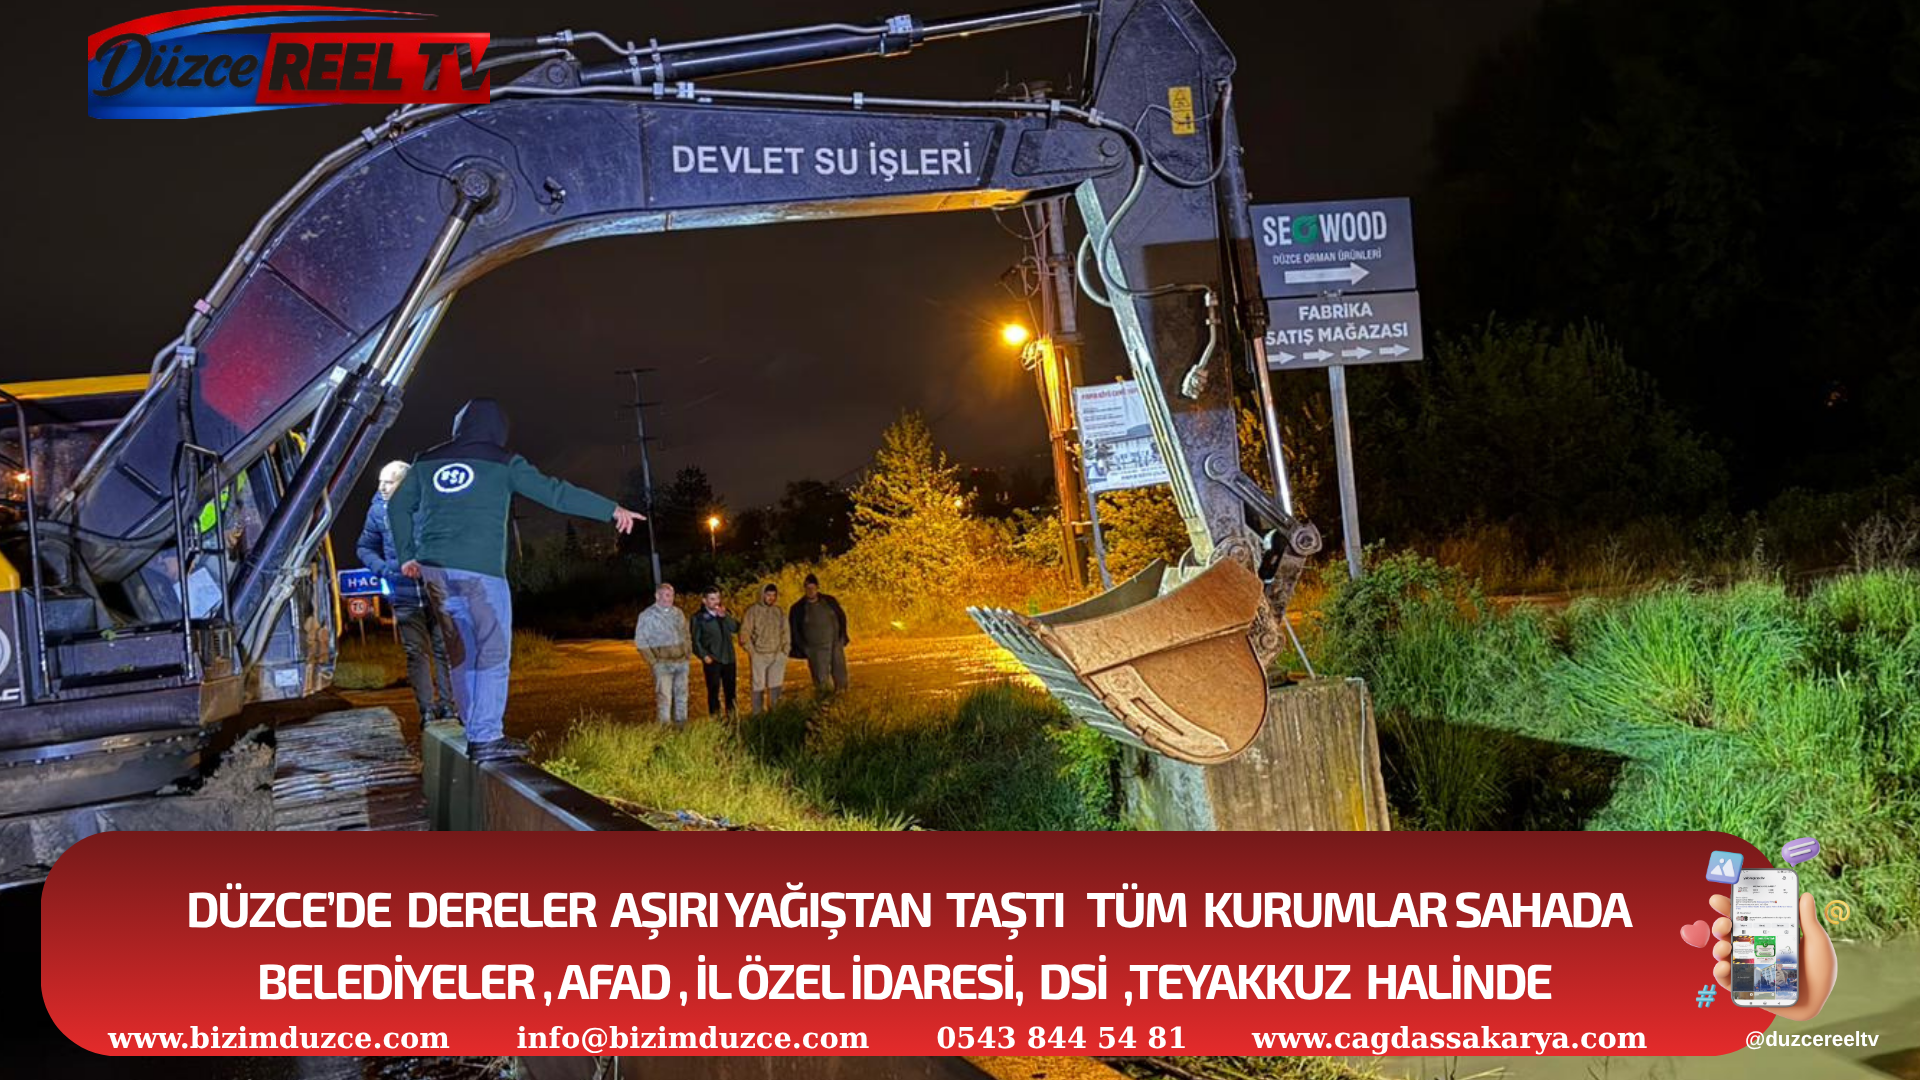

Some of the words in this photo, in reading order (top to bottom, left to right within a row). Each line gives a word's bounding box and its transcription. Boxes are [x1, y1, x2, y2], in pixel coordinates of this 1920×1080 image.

[672, 145, 804, 174] DEVLET
[815, 147, 858, 175] SU
[869, 141, 972, 182] İŞLERİ
[1273, 252, 1302, 265] DÜZCE
[1303, 250, 1336, 263] ORMAN
[1338, 247, 1382, 261] ÜRÜNLERİ
[1298, 302, 1373, 321] FABRİKA
[1265, 328, 1314, 346] SATIŞ
[1317, 322, 1408, 342] MAĞAZASI
